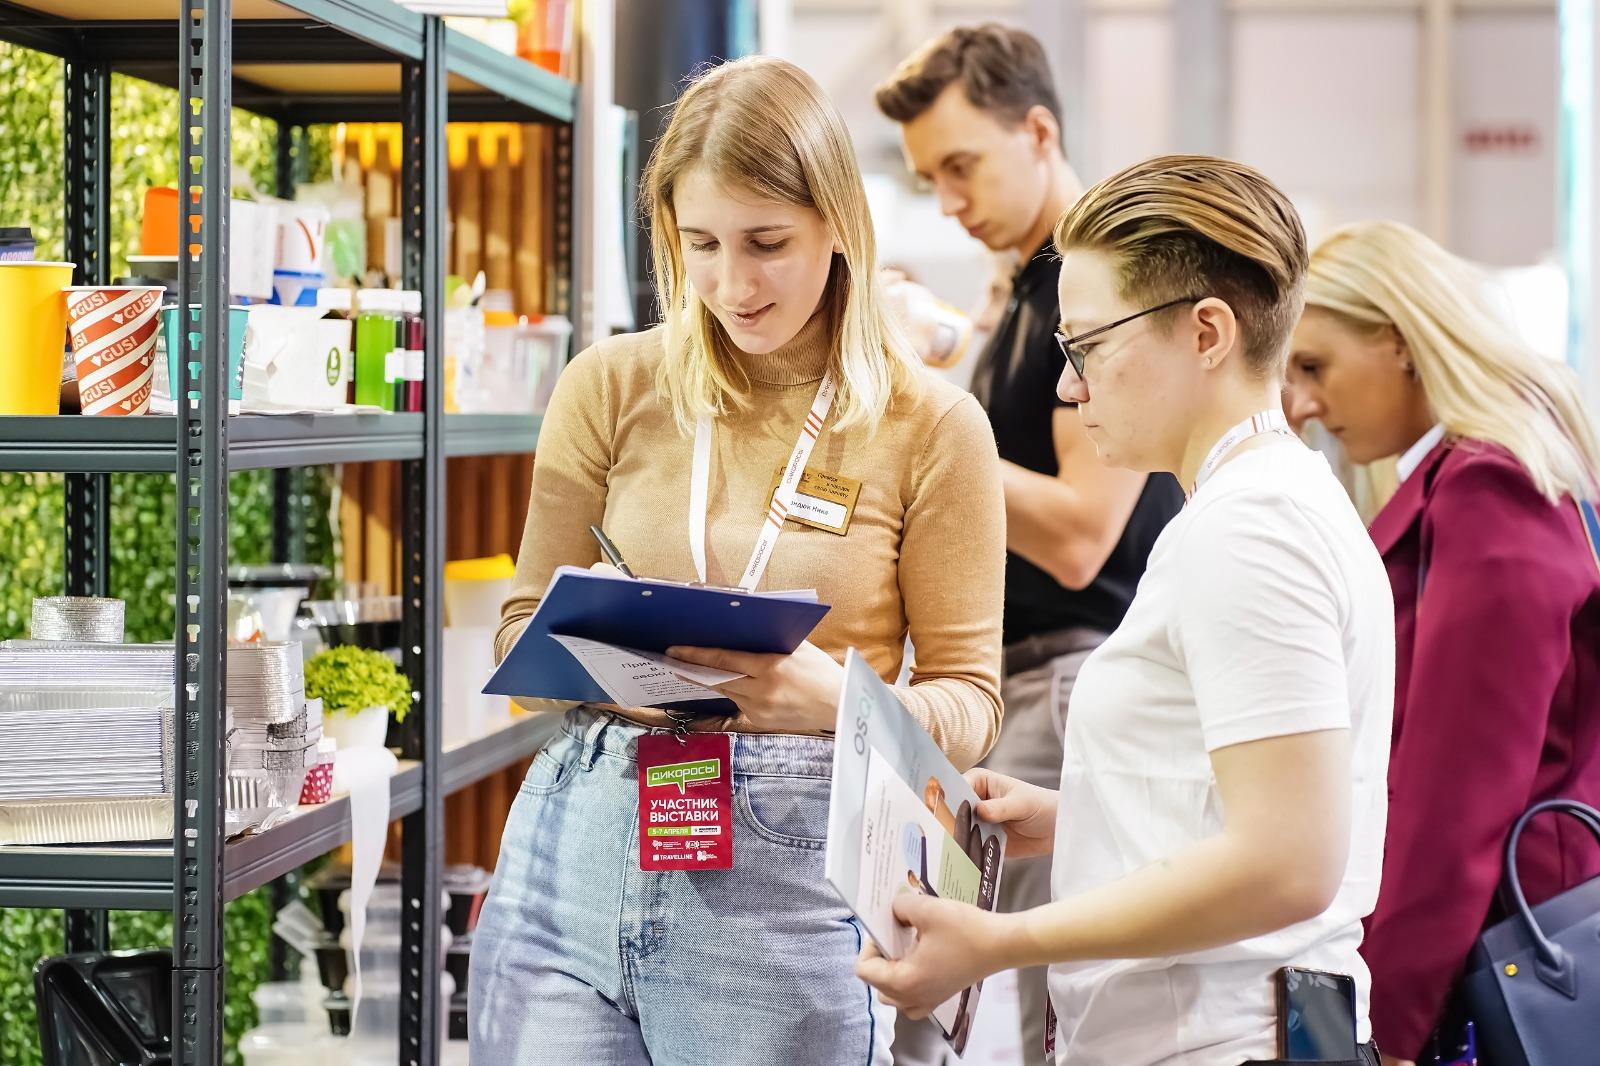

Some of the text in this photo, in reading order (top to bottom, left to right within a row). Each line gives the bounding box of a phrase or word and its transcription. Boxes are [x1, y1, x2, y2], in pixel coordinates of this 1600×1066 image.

[76, 292, 109, 317] GUSI
[124, 292, 155, 319] GUSI
[101, 336, 138, 362] GUSI
[83, 379, 116, 404] GUSI
[651, 765, 715, 781] ДИКОРОСЫ
[650, 798, 718, 810] УЧАСТНИК
[650, 811, 719, 823] ВЫСТАВКИ
[982, 840, 994, 897] КАТАЛОГ
